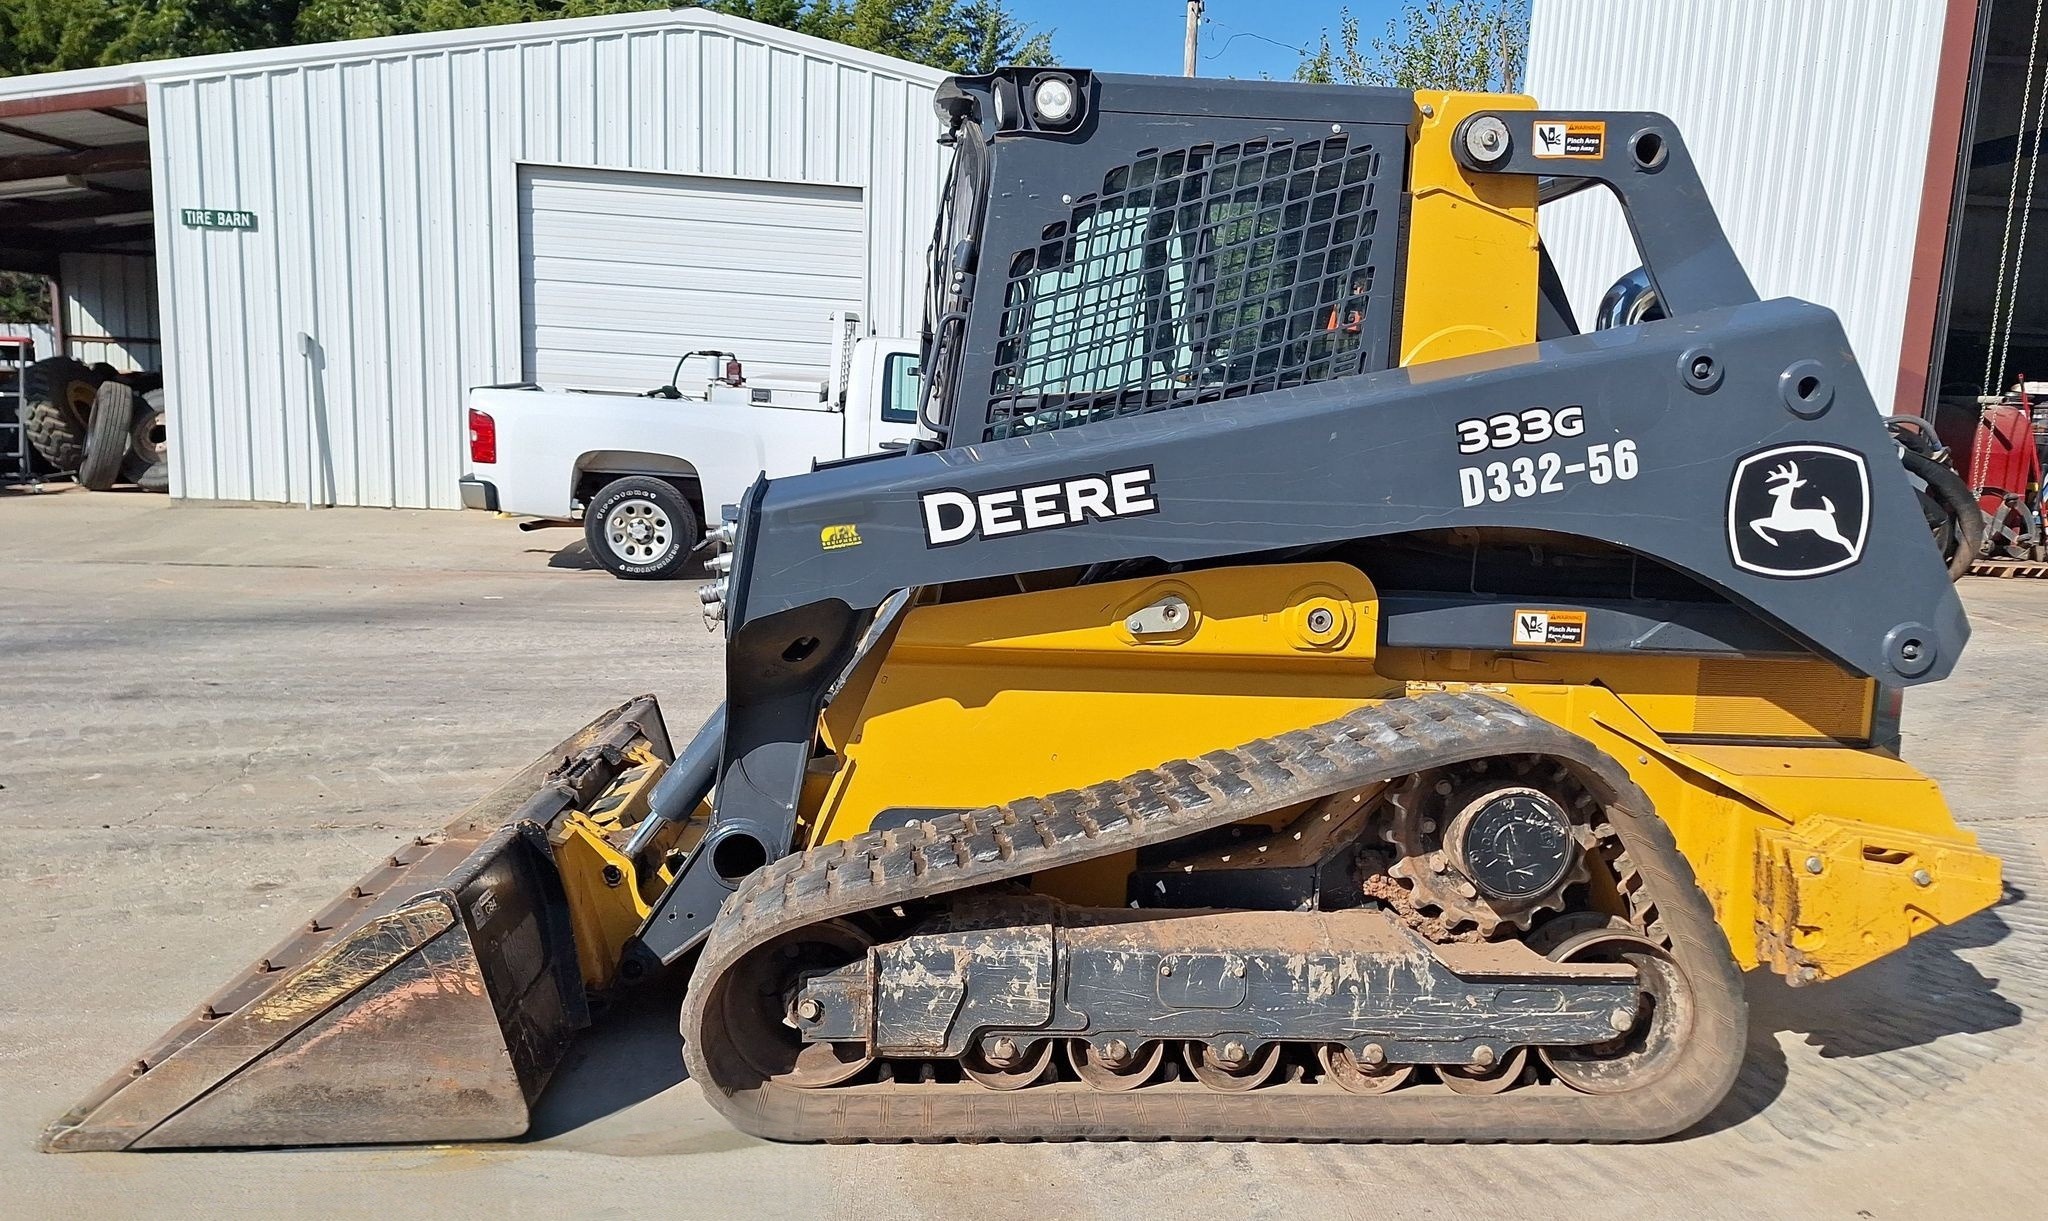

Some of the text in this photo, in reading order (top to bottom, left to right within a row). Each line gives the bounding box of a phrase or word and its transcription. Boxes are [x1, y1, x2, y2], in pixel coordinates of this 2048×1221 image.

[185, 210, 251, 227] TIRE BARN
[1457, 406, 1585, 455] 333G
[1458, 438, 1639, 508] D332-56
[921, 467, 1157, 545] DEERE
